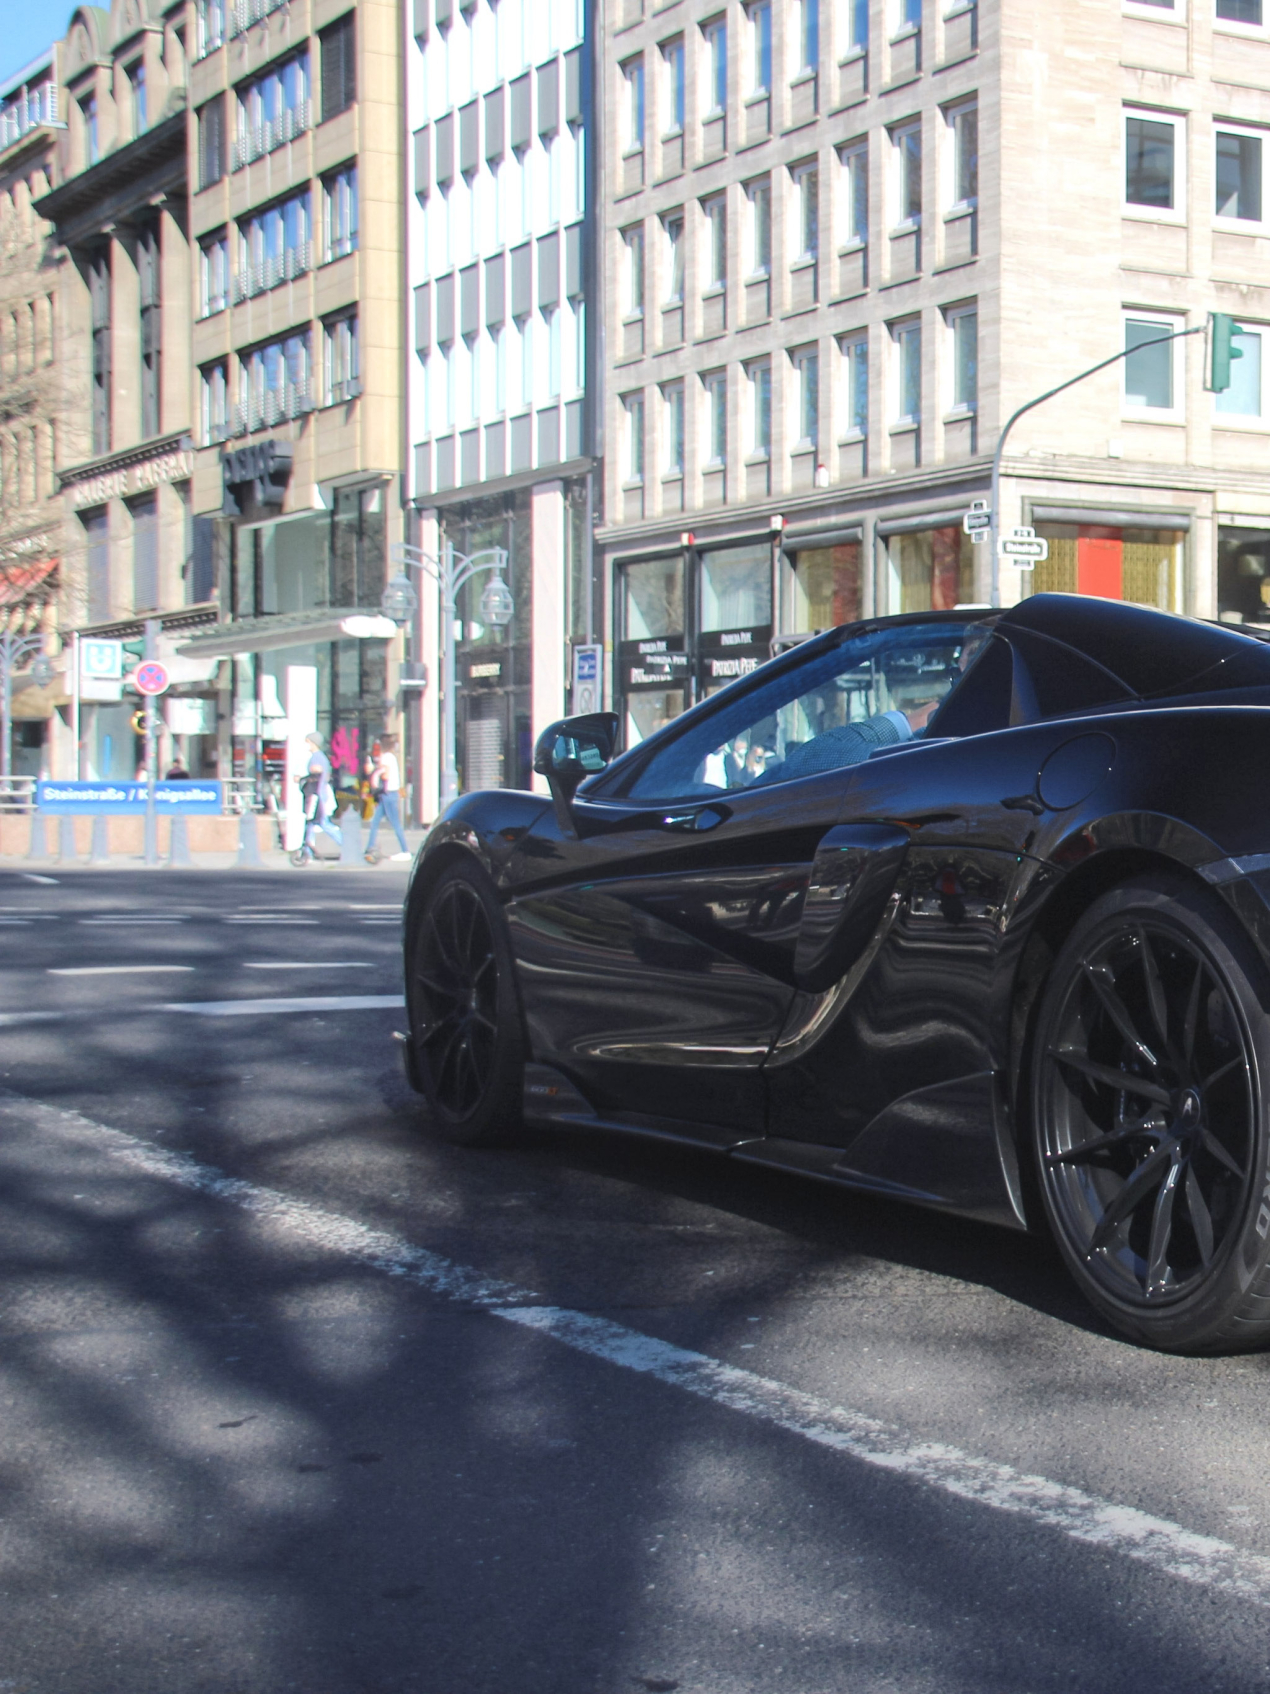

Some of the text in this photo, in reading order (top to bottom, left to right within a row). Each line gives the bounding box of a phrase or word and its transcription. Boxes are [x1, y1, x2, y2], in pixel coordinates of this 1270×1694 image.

[712, 659, 740, 677] PATRIZIA
[44, 787, 126, 800] Steinstraße
[128, 788, 136, 802] /
